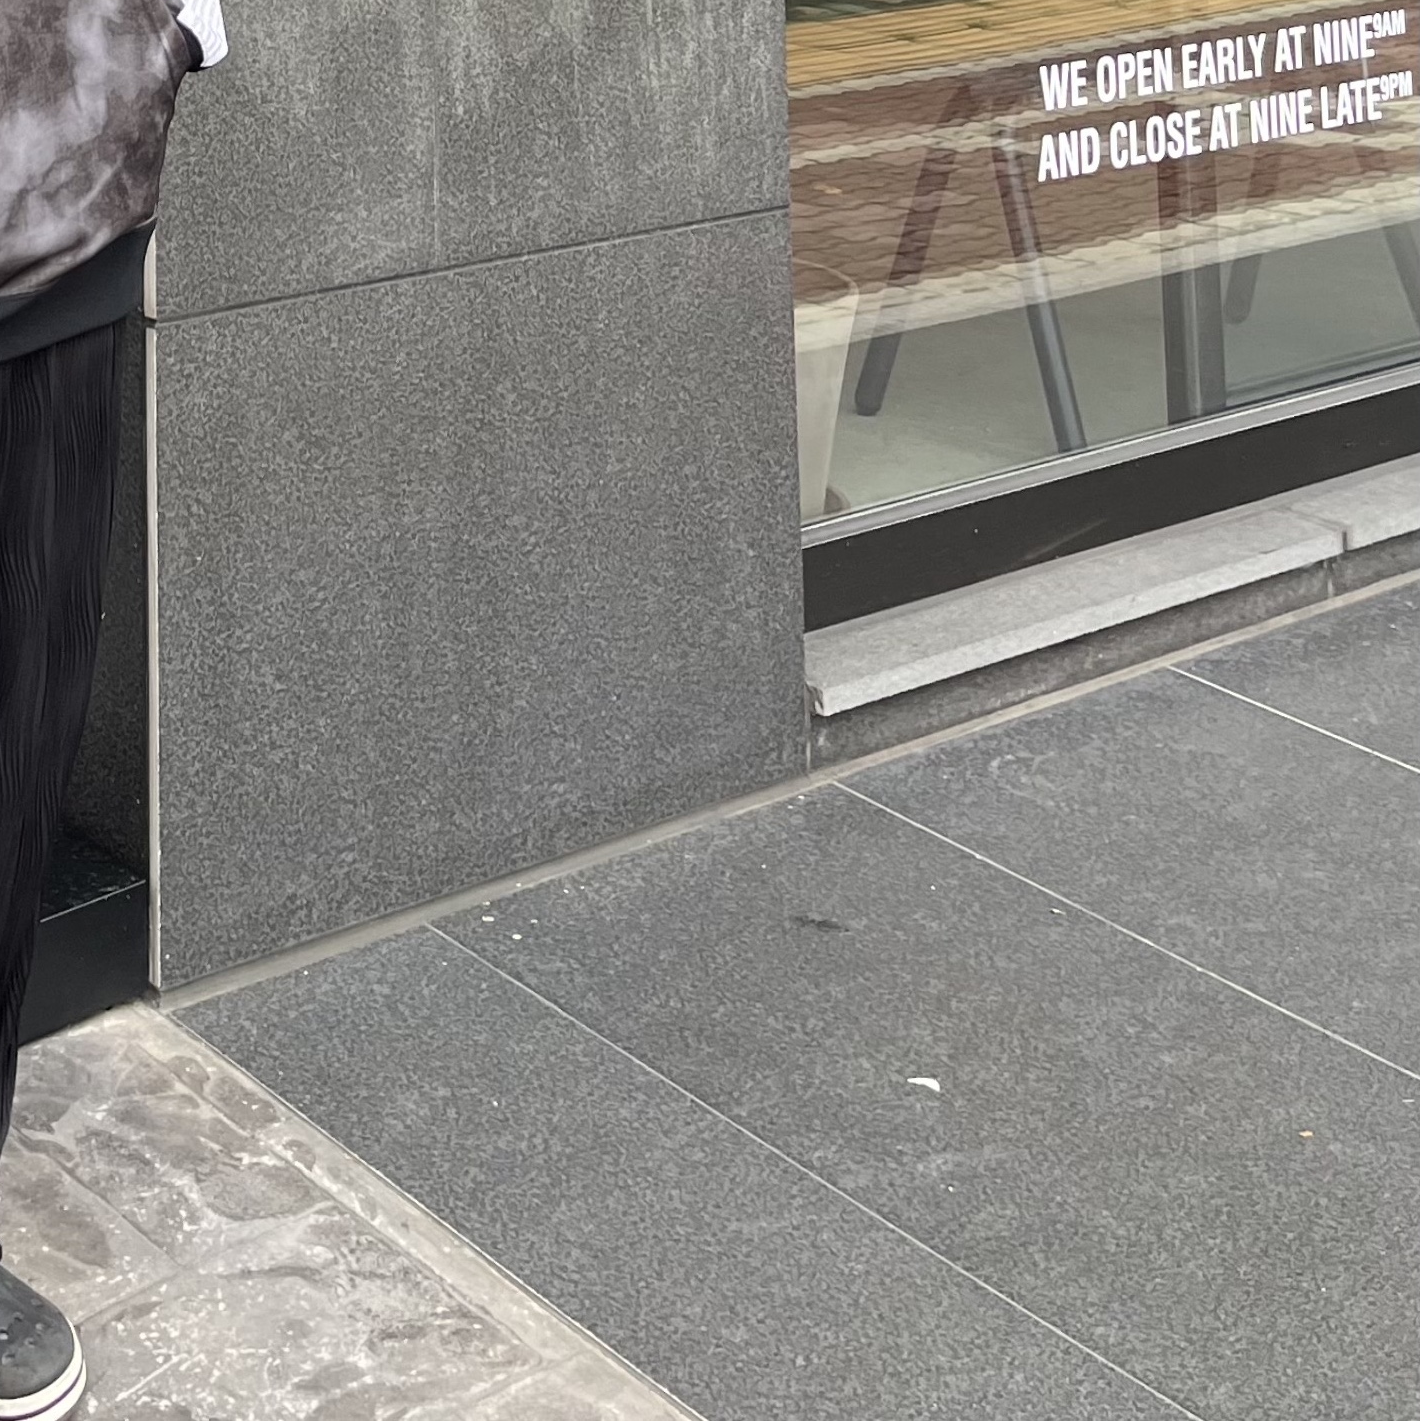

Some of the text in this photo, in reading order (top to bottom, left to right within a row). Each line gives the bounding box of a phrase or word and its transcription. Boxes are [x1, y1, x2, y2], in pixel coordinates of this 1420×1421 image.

[1039, 60, 1088, 111] WE
[1096, 47, 1173, 103] OPEN
[1181, 33, 1267, 89] EARLY
[1275, 25, 1306, 73] AT
[1038, 127, 1100, 183] AND
[1110, 109, 1202, 170] CLOSE
[1209, 103, 1242, 152] AT
[1250, 89, 1314, 143] NINE
